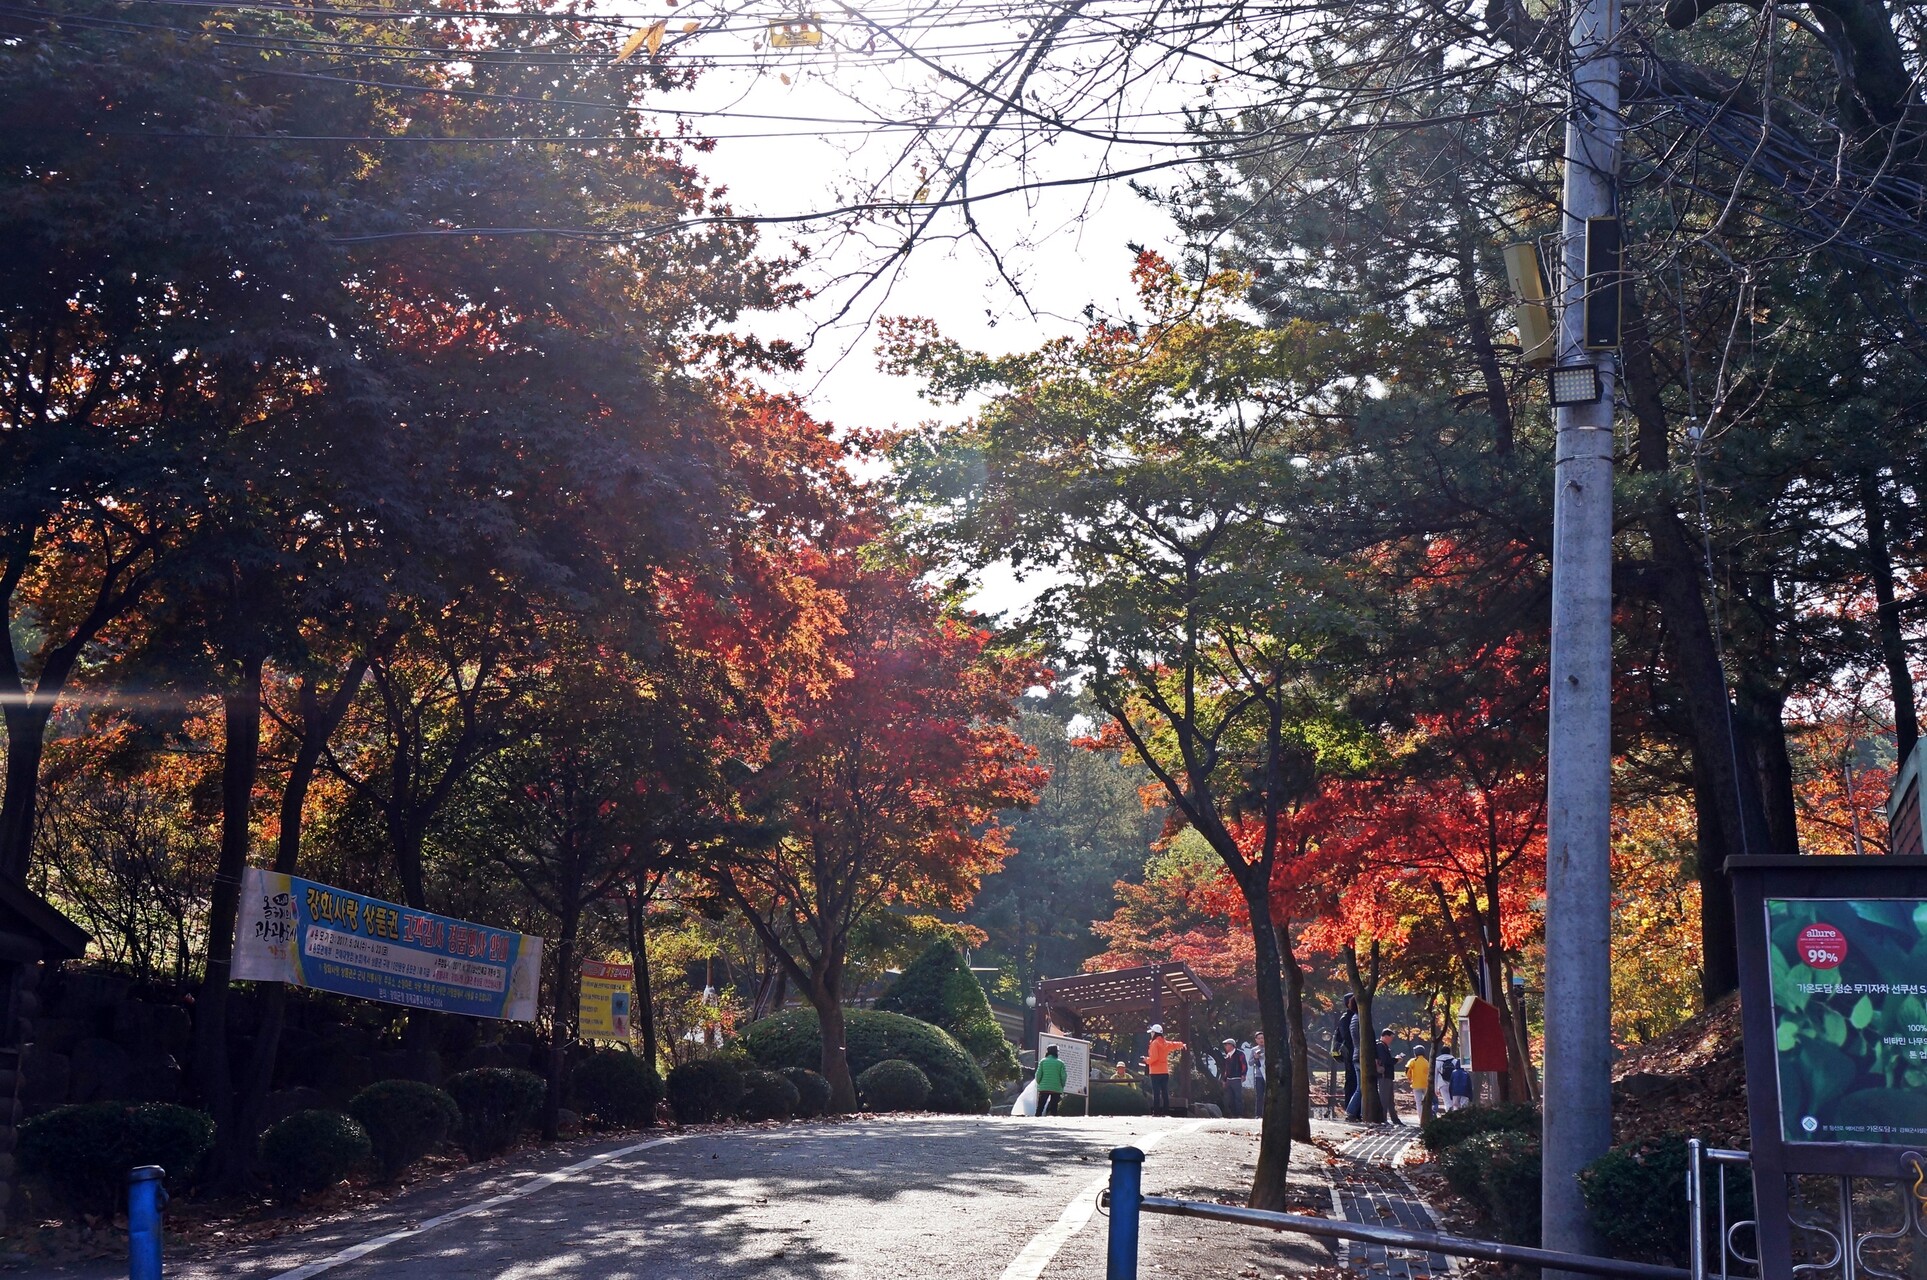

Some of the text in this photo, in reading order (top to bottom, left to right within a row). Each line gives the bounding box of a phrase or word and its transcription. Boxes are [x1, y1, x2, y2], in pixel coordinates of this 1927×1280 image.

[307, 887, 510, 962] 강화사랑 상품권 고객감사 경품행사 안내
[255, 920, 297, 943] 관광도시
[1806, 929, 1836, 938] allure
[1808, 949, 1838, 962] 99%
[1797, 983, 1832, 994] 가온도담
[1835, 984, 1853, 994] 청순
[1854, 984, 1890, 994] 무기자차
[1891, 984, 1919, 995] 선쿠션
[1883, 1037, 1906, 1046] 비타민
[1909, 1050, 1918, 1059] 톤
[1866, 1125, 1891, 1133] 가온도담
